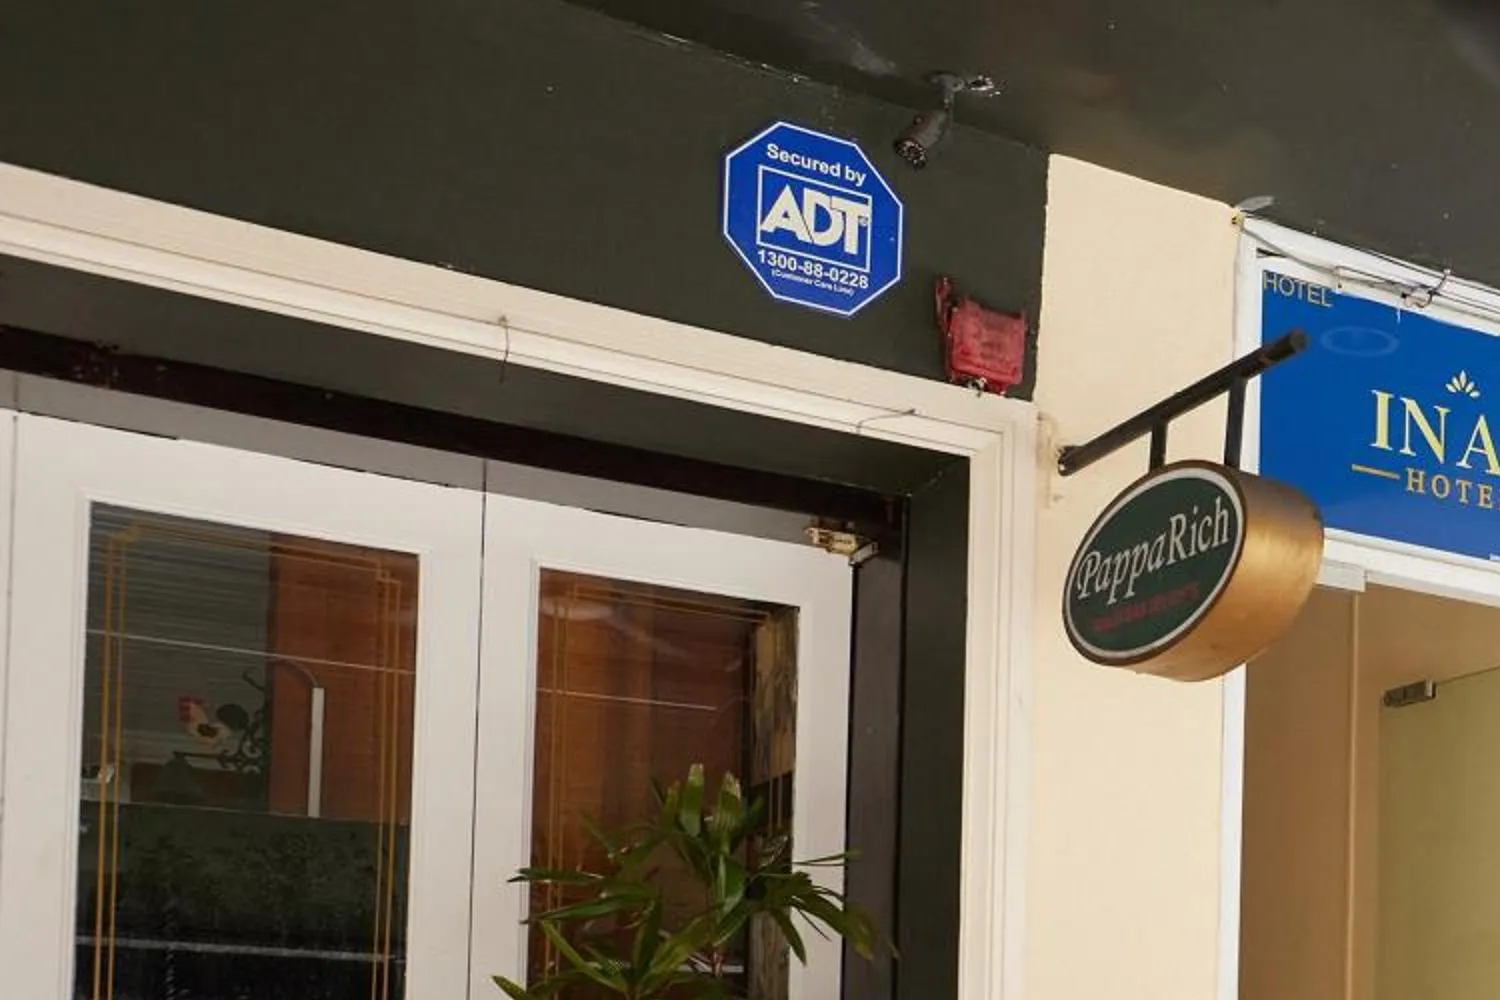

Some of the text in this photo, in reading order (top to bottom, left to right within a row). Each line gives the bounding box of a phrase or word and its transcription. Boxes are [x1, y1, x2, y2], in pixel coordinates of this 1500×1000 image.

[766, 143, 867, 187] Secured by
[760, 183, 869, 255] ADT
[758, 249, 869, 289] 1300-88-0228
[1262, 270, 1335, 308] HOTEL
[1076, 495, 1230, 605] PappaRich
